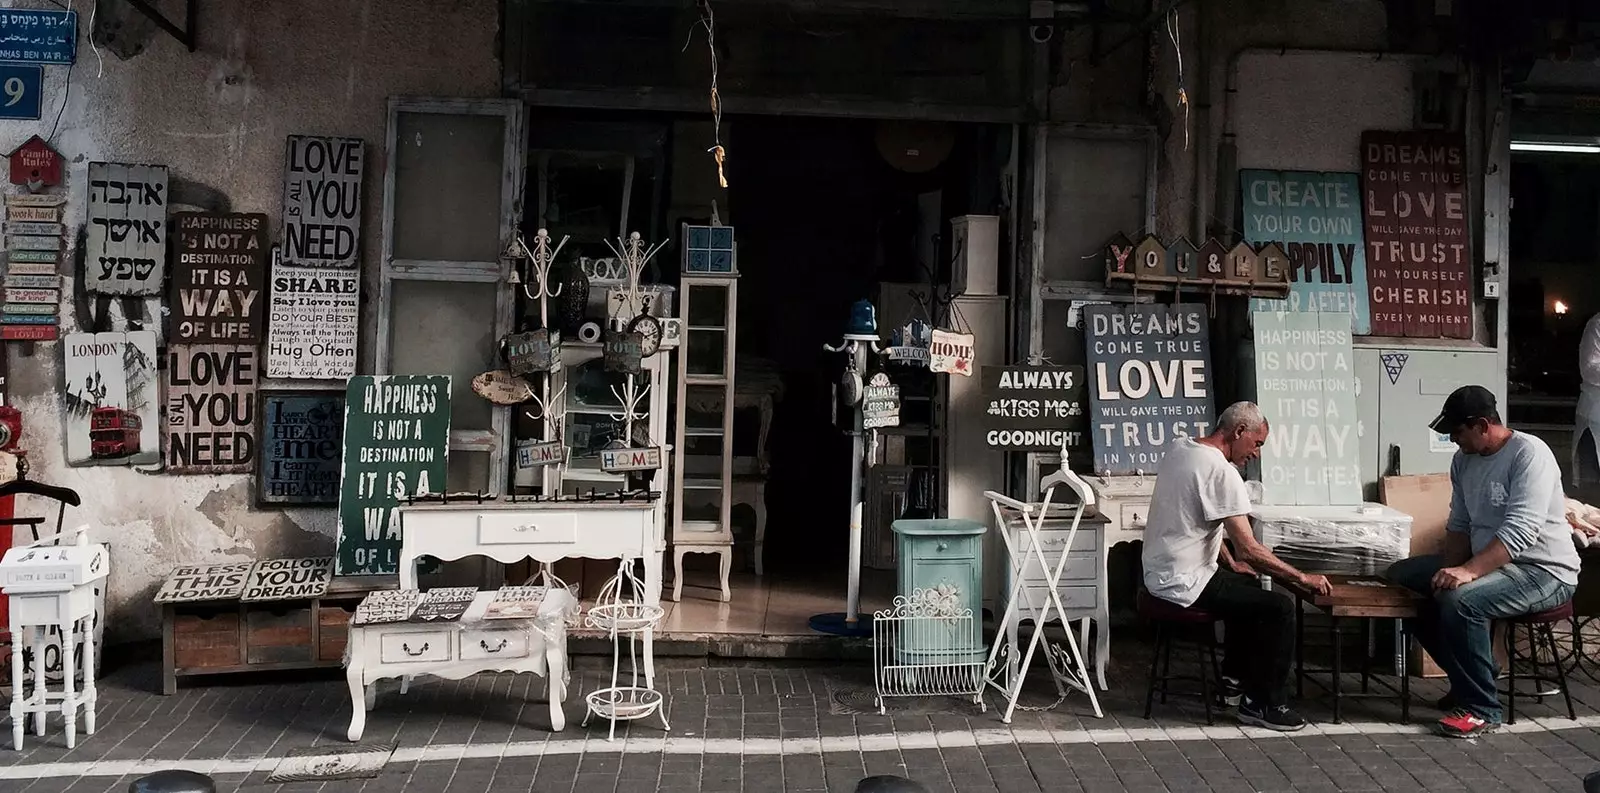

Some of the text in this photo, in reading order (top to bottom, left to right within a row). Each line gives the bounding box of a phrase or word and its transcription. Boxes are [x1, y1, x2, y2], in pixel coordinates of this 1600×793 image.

[24, 51, 39, 59] BEN
[4, 77, 25, 107] 9
[20, 149, 54, 159] Family
[23, 158, 51, 167] Rules
[290, 140, 360, 175] LOVE
[1368, 143, 1460, 165] DREAMS
[1368, 169, 1461, 184] COME TRUE
[91, 181, 163, 206] אהבה
[288, 180, 302, 216] IS ALL
[306, 180, 358, 219] YOU
[1250, 180, 1350, 208] CREATE
[1368, 190, 1463, 220] LOVE
[11, 209, 54, 219] work hard
[92, 218, 161, 244] אושר
[181, 217, 260, 231] HAPPINESS
[1253, 214, 1353, 235] YOUR OWN
[1371, 224, 1462, 236] WILL THE DAY
[204, 234, 259, 250] NOT A
[285, 223, 354, 260] NEED
[181, 253, 255, 265] DESTINATION
[1370, 241, 1465, 264] TRUST
[98, 256, 156, 281] שפע
[275, 269, 296, 277] Keep
[1373, 269, 1465, 281] IN YOURSELF
[191, 269, 249, 286] IT IS A
[274, 278, 357, 293] SHARE
[179, 289, 259, 317] WAY
[273, 297, 296, 306] Say
[306, 298, 331, 306] love
[1373, 286, 1468, 306] CHERISH
[1308, 291, 1359, 320] AFTER
[292, 313, 322, 322] YOUR
[326, 314, 355, 322] BEST
[1093, 312, 1201, 336] DREAMS
[1375, 312, 1469, 324] EVERY MOMENT
[179, 321, 205, 338] OF
[272, 329, 300, 337] Always
[1260, 330, 1346, 345] HAPPINESS
[272, 336, 300, 344] Laugh
[1095, 340, 1201, 354] COME TRUE
[72, 343, 118, 357] LONDON
[271, 343, 354, 359] Hug Often
[932, 342, 974, 360] HOME
[170, 352, 253, 386] LOVE
[1261, 351, 1348, 371] IS NOT A
[270, 368, 353, 376] Love Each Other
[999, 371, 1073, 389] ALWAYS
[1096, 359, 1207, 400] LOVE
[867, 386, 896, 398] ALWAYS
[1263, 379, 1348, 392] DESTINATION.
[364, 384, 437, 414] HAPPINESS
[1000, 398, 1070, 417] KISS ME
[170, 394, 184, 426] IS ALL
[184, 393, 253, 426] YOU
[1101, 405, 1206, 416] WILL THE DAY
[1278, 398, 1339, 418] IT IS A
[272, 425, 340, 439] HEART
[372, 419, 422, 440] IS NOT A
[987, 430, 1081, 446] GOODNIGHT
[1100, 421, 1209, 447] TRUST
[170, 431, 254, 466] NEED
[280, 439, 336, 460] me
[1270, 424, 1350, 459] WAY
[360, 447, 434, 463] DESTINATION
[520, 445, 561, 464] HOME
[603, 450, 657, 467] HOME
[1104, 453, 1119, 464] IN
[1270, 466, 1296, 485] OF
[270, 481, 340, 497] HEART
[358, 470, 430, 500] IT IS A
[259, 557, 333, 571] FOLLOW
[355, 547, 378, 566] OF
[176, 564, 249, 576] BLESS
[255, 568, 329, 586] YOUR
[173, 574, 244, 589] THIS
[160, 587, 240, 599] HOME
[247, 583, 325, 598] DREAMS
